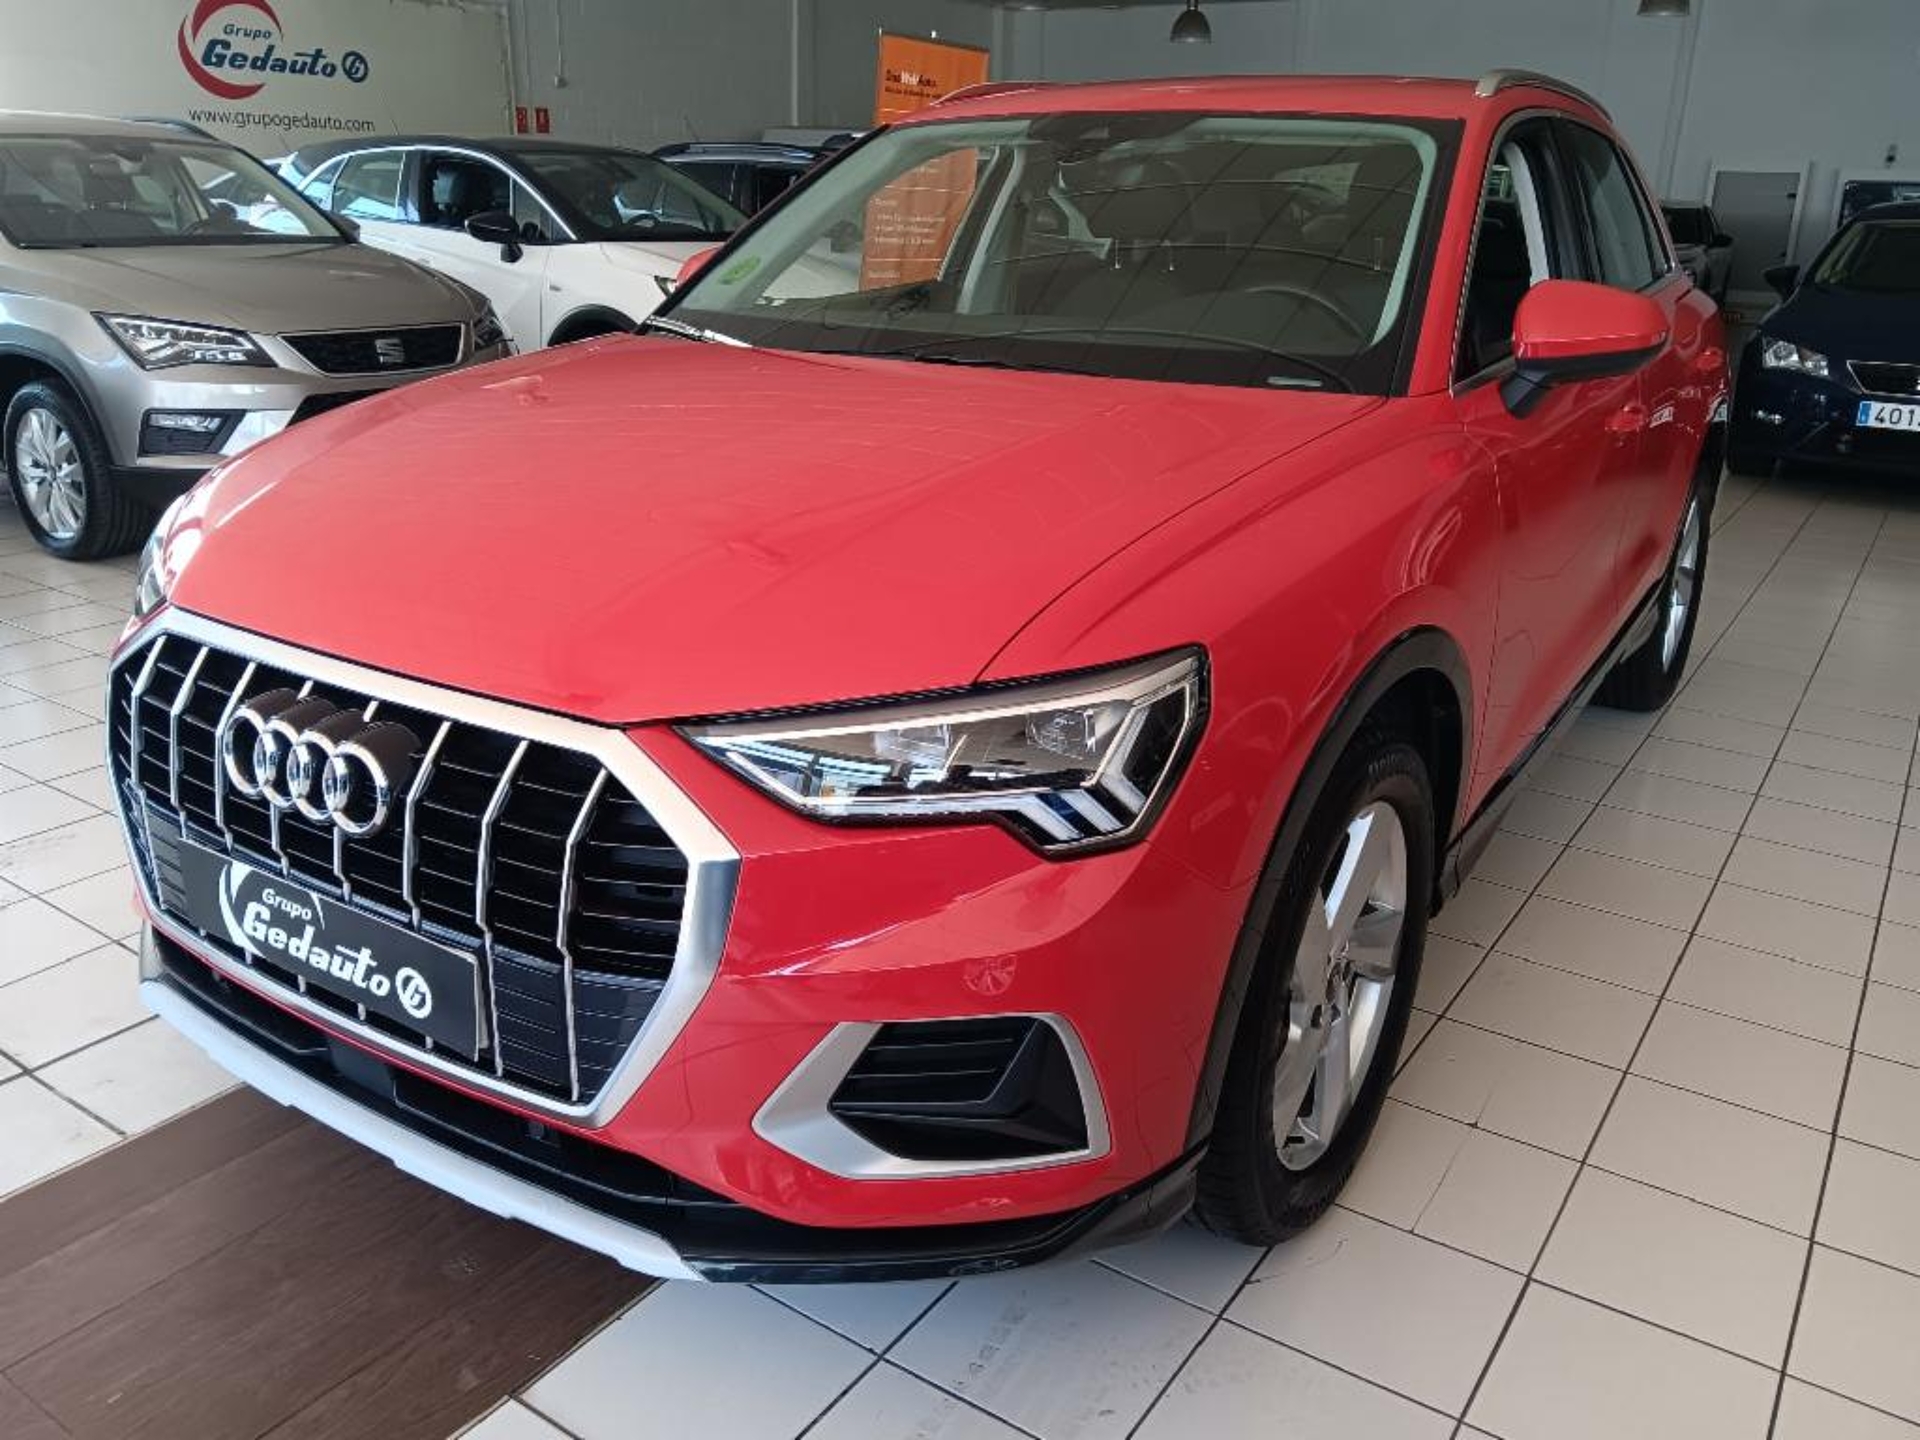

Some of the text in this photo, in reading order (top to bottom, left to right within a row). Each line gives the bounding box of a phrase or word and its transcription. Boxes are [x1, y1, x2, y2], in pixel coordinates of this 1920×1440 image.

[223, 24, 272, 40] Grupo
[201, 39, 338, 78] Gedauto
[189, 108, 375, 131] www.grupogedauto.com
[1874, 406, 1920, 427] 401
[262, 888, 312, 921] Grupo
[243, 901, 391, 996] Gedauto
